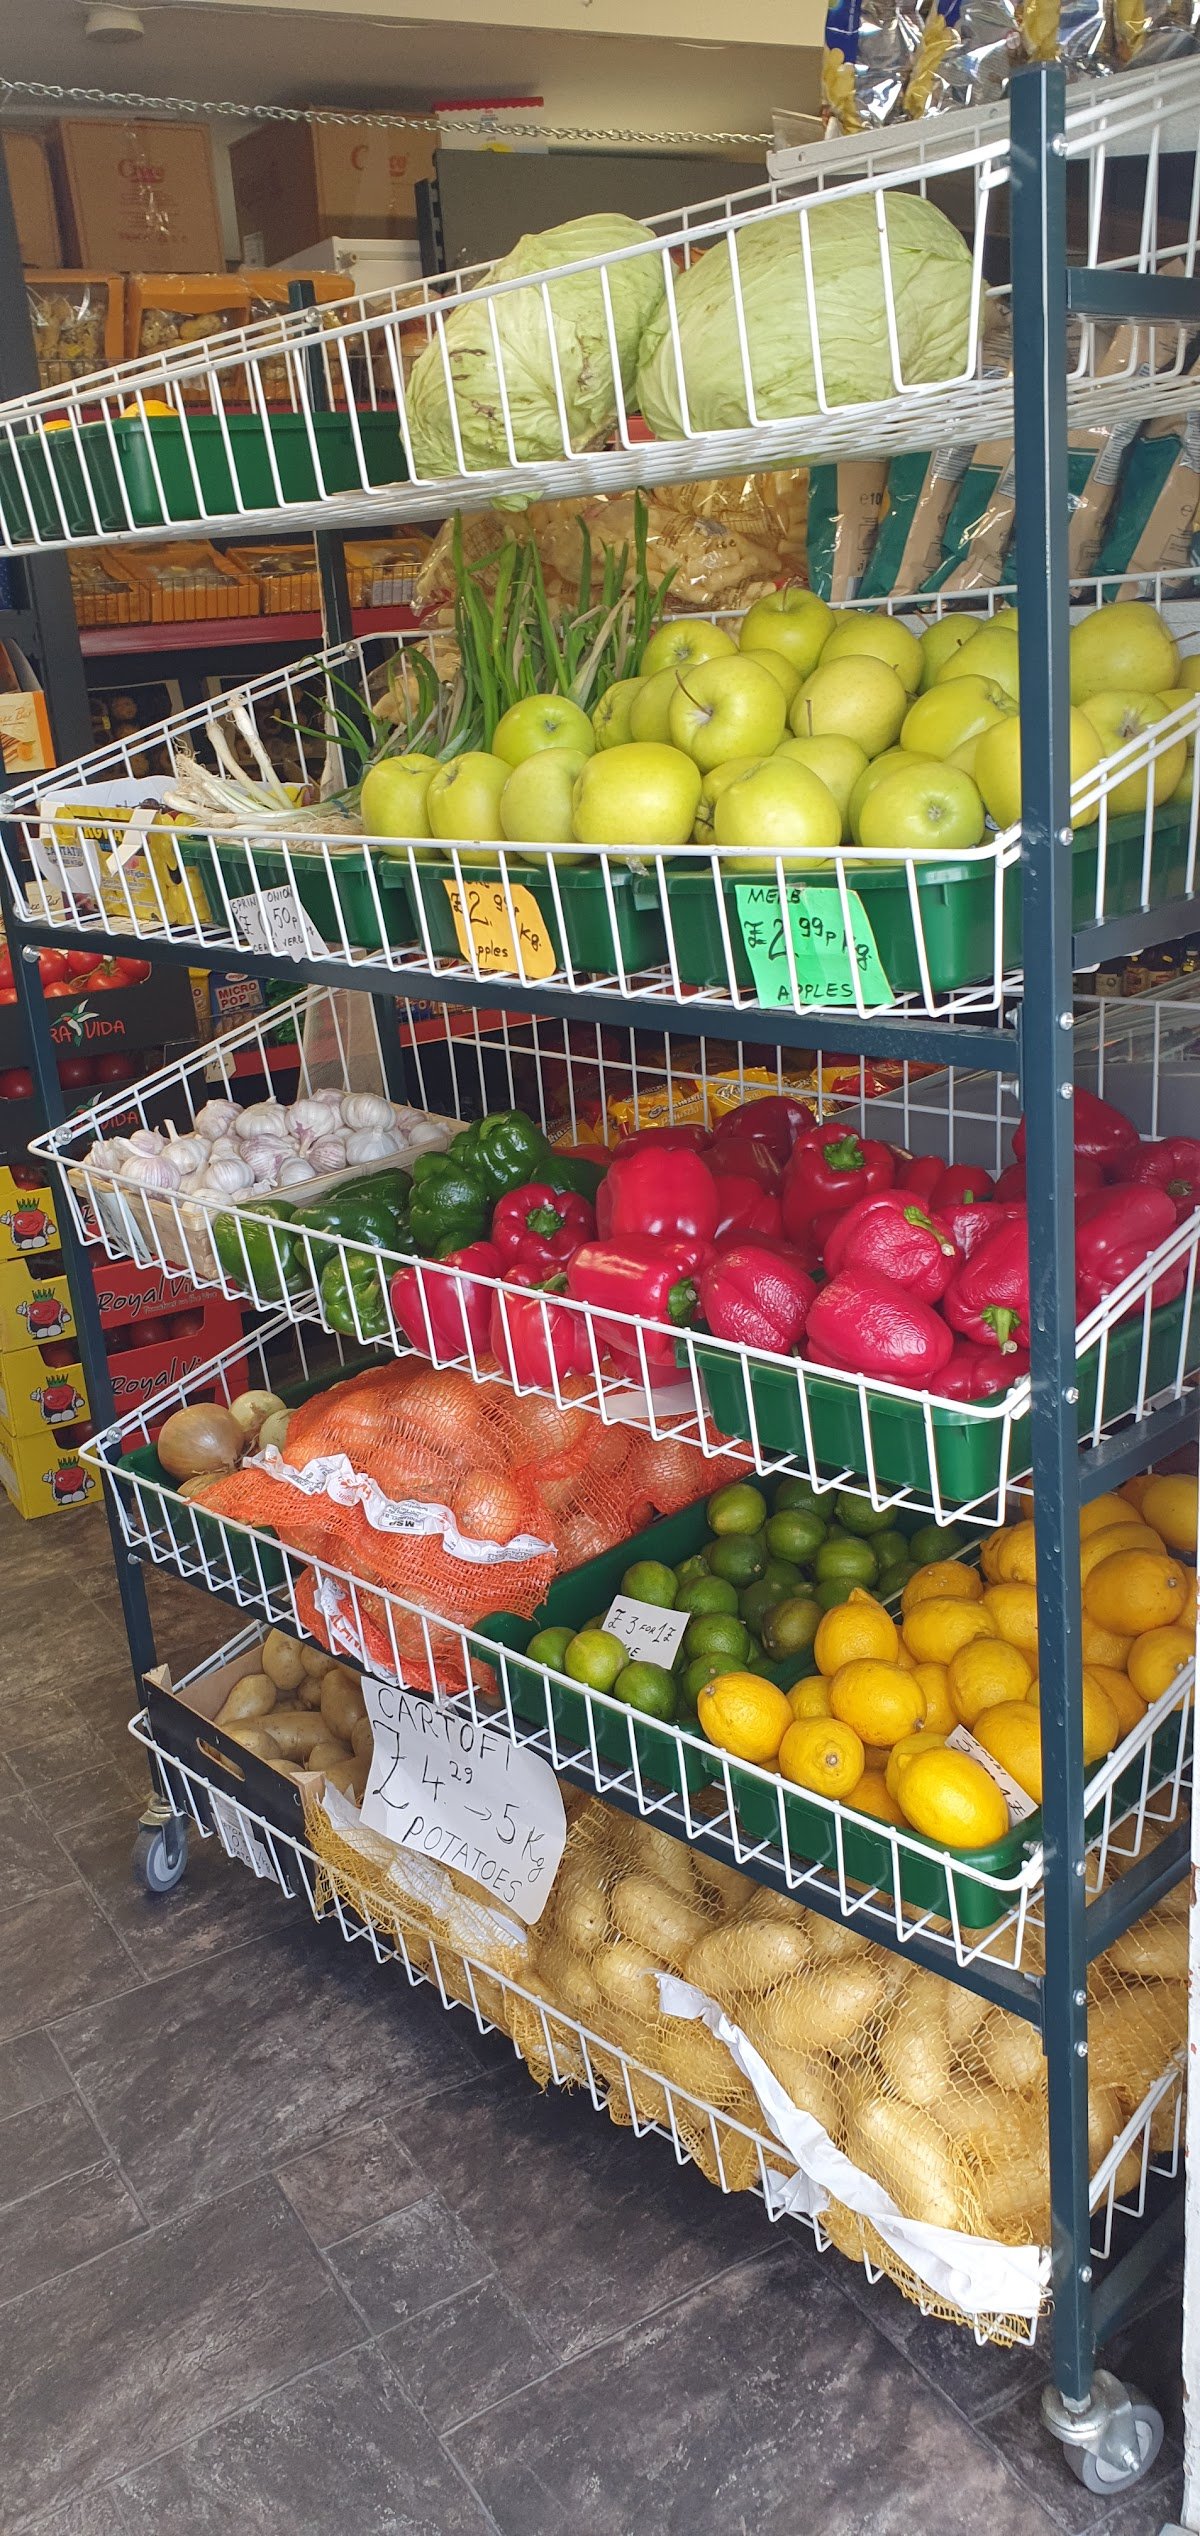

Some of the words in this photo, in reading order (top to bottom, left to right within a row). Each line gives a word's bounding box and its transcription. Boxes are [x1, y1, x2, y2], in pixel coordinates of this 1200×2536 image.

[469, 939, 509, 963] pples
[218, 982, 258, 1000] MICRO
[221, 994, 247, 1009] POP
[84, 1019, 126, 1040] VIDA
[111, 1355, 178, 1399] Royal
[377, 1687, 513, 1772] CARTOFI
[401, 1815, 523, 1903] POTATOES
